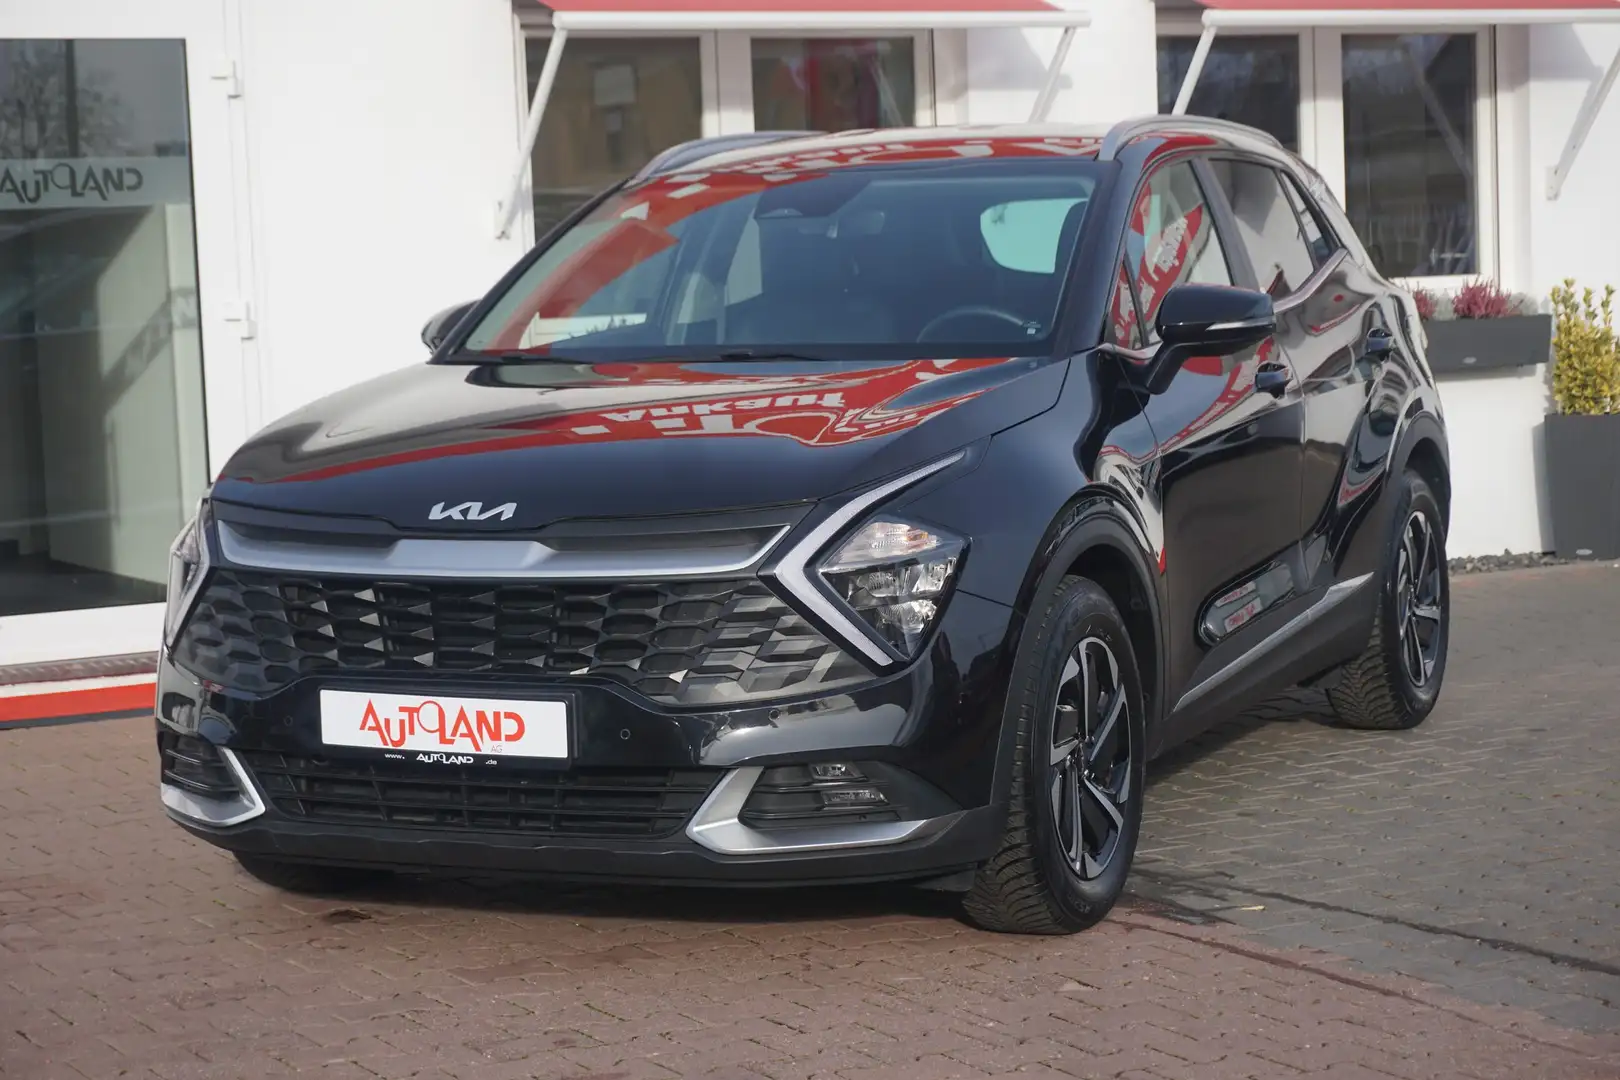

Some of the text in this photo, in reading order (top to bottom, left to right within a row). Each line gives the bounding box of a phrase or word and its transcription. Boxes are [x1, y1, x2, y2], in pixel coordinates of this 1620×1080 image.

[0, 163, 143, 204] AUTOLAND
[428, 501, 518, 521] KIA
[359, 699, 526, 752] AUTOLAND
[416, 753, 474, 765] AUTOLAND
[491, 745, 503, 754] AG
